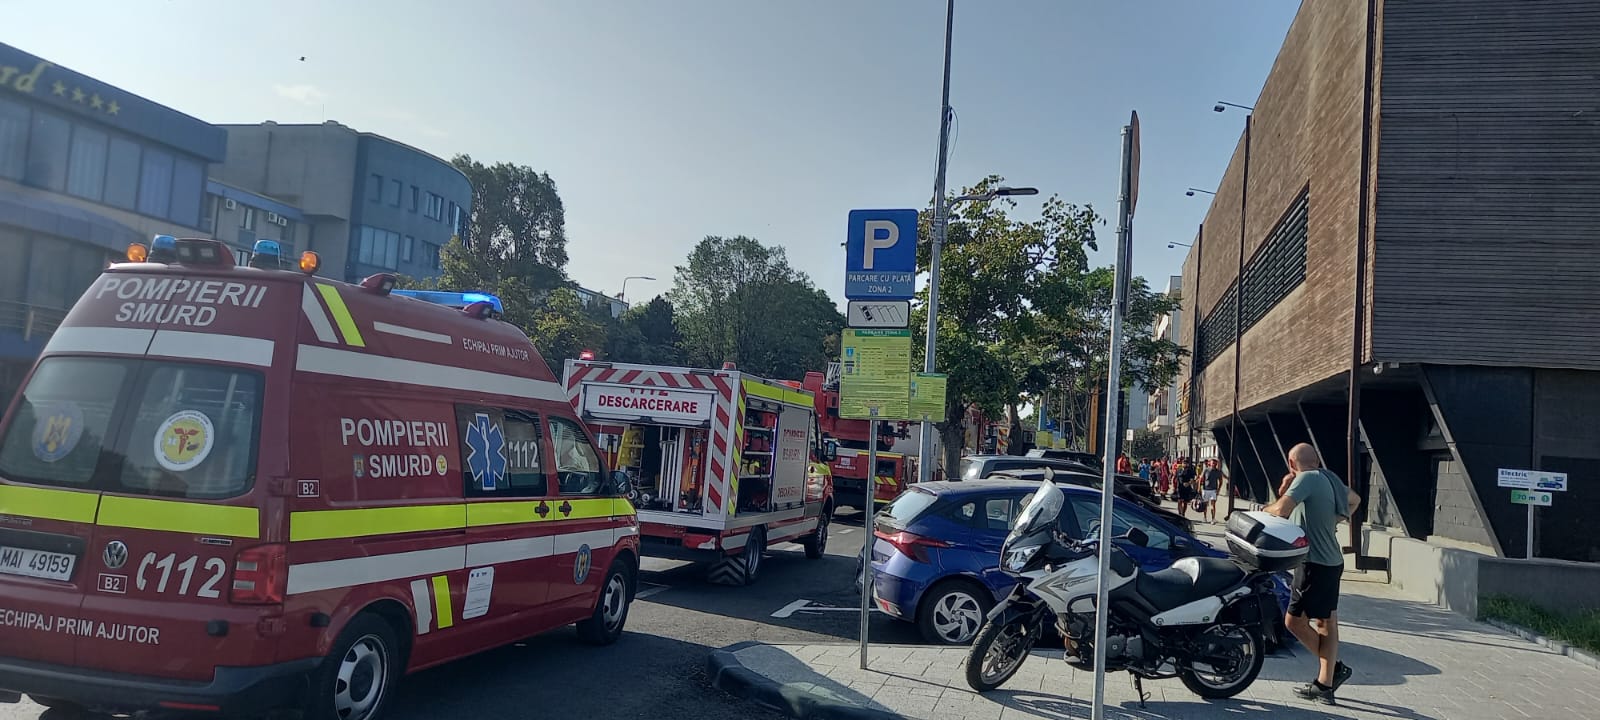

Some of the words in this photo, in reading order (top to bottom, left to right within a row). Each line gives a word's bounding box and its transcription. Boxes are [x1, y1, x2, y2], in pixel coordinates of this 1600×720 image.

[863, 220, 899, 269] P
[848, 274, 878, 282] PARCARE
[880, 274, 890, 282] CU
[868, 285, 887, 293] ZONA
[96, 278, 267, 308] POMPIERII
[115, 302, 217, 326] SMURD
[462, 338, 490, 354] ECHIPAJ
[490, 344, 506, 357] PRIM
[507, 347, 530, 361] AJUTOR
[598, 395, 698, 413] DESCARCERARE
[341, 418, 449, 447] POMPIERII
[369, 454, 432, 478] SMURD
[513, 440, 539, 468] 112
[302, 483, 314, 495] B2
[0, 549, 24, 568] MAI
[29, 553, 70, 574] 49159
[104, 577, 120, 590] B2
[156, 552, 226, 598] 112
[56, 617, 93, 637] PRIM
[96, 622, 160, 645] AJUTOR
